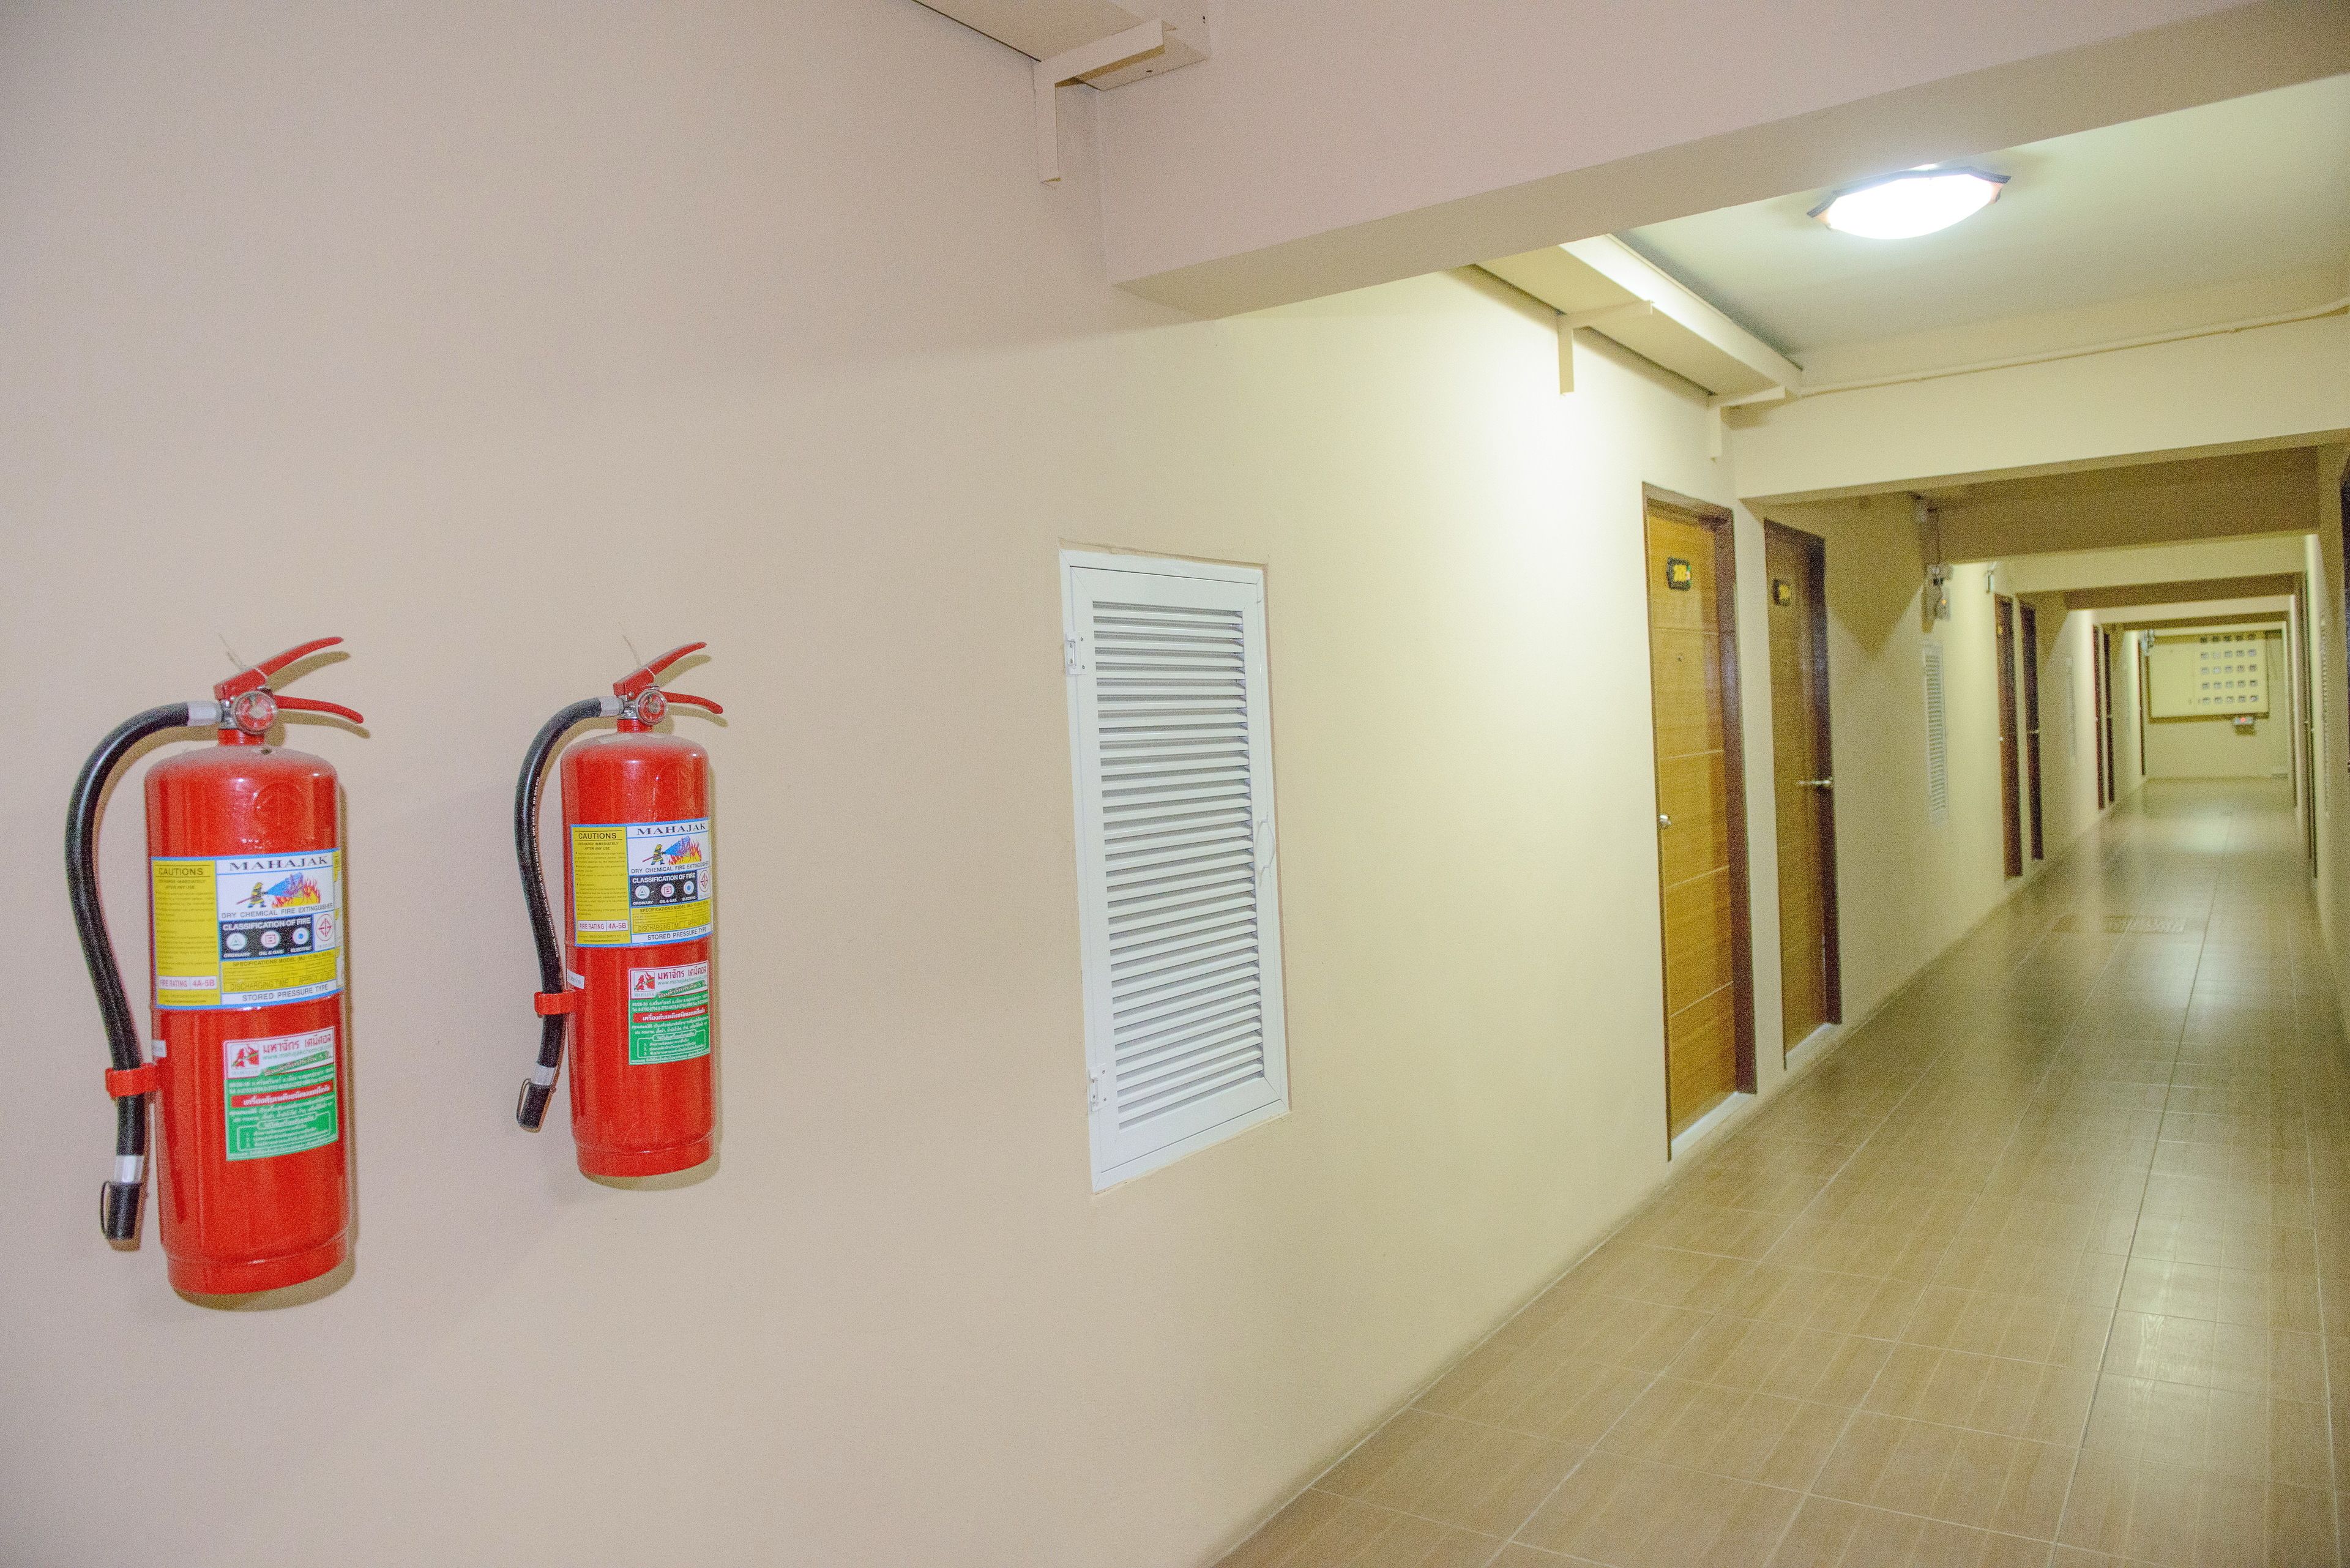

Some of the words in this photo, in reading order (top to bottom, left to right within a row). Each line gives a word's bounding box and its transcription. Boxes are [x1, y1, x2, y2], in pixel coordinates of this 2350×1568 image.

[637, 823, 706, 835] MAHAJAK
[229, 856, 327, 871] MAHAJAK
[632, 875, 678, 883] CLASSIFICATION
[240, 908, 278, 917] CHEMICAL
[223, 920, 285, 931] CLASSIFICATION
[673, 929, 698, 938] PRESSURE
[657, 969, 685, 980] มหาจักร
[230, 982, 274, 991] DISCHARGING
[242, 993, 274, 1002] STORED
[277, 987, 313, 998] PRESSURE
[263, 1039, 299, 1054] มหาจักร
